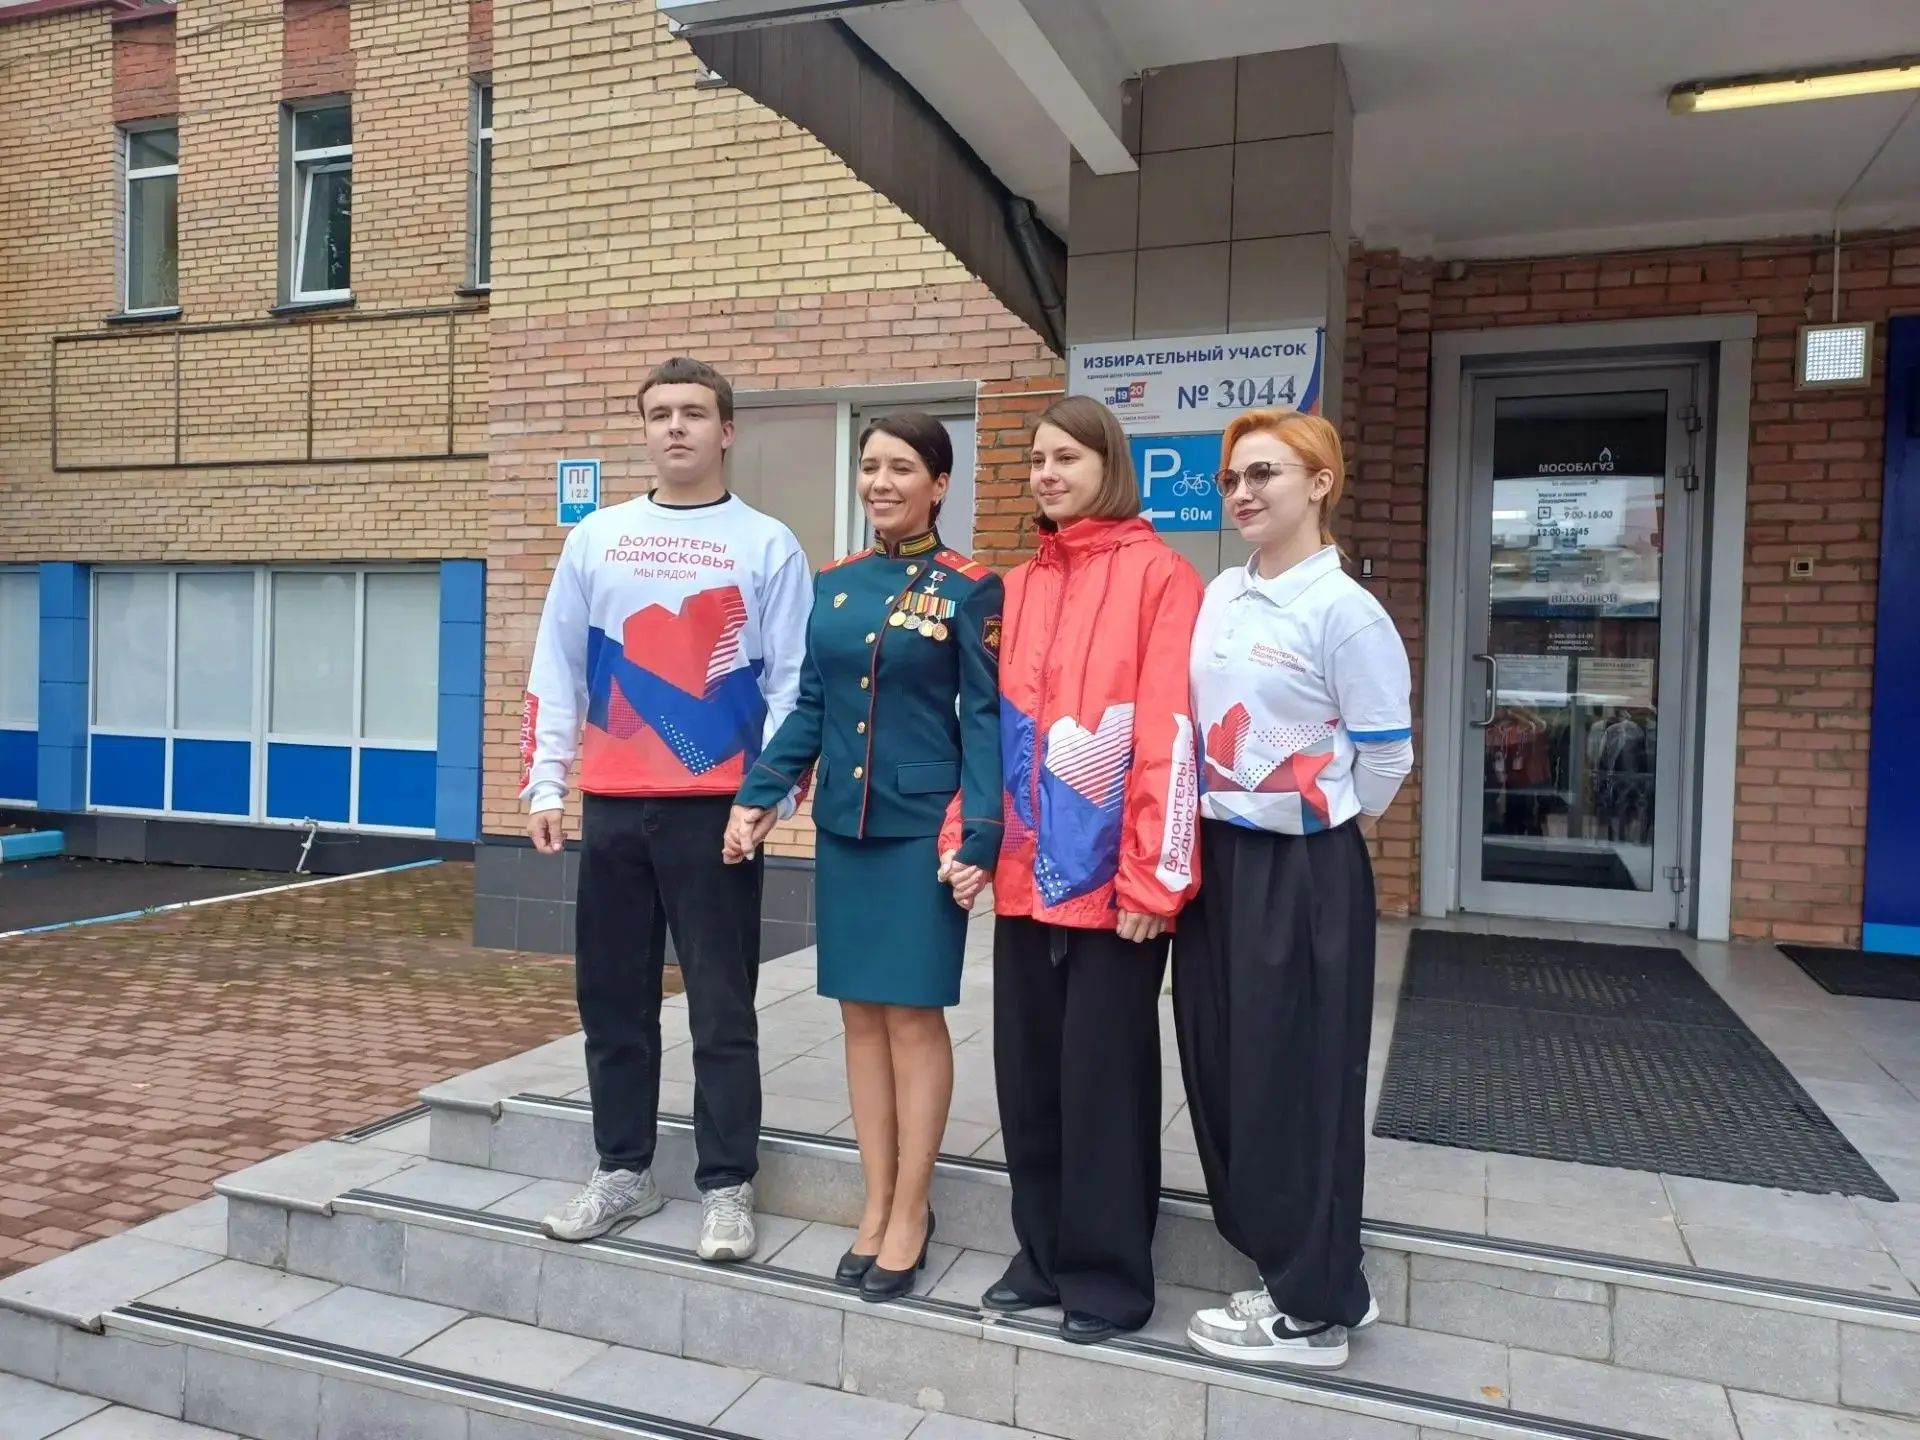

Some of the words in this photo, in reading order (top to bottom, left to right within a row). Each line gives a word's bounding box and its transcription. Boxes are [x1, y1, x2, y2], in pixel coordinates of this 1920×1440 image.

[1083, 345, 1224, 370] ИЗБИРАТЕЛЬНЫЙ
[1228, 342, 1307, 360] УЧАСТОК
[1117, 390, 1128, 400] 19
[1130, 385, 1143, 395] 20
[1216, 375, 1297, 408] 3044
[568, 468, 592, 485] ПГ
[1143, 447, 1182, 498] P
[618, 534, 728, 554] ВОЛОНТЕРЫ
[604, 548, 736, 571] ПОДМОСКОВЬЯ
[633, 567, 655, 577] МЫ
[656, 569, 698, 581] РЯДОМ
[1164, 760, 1188, 874] ВОЛОНТЕРЫ
